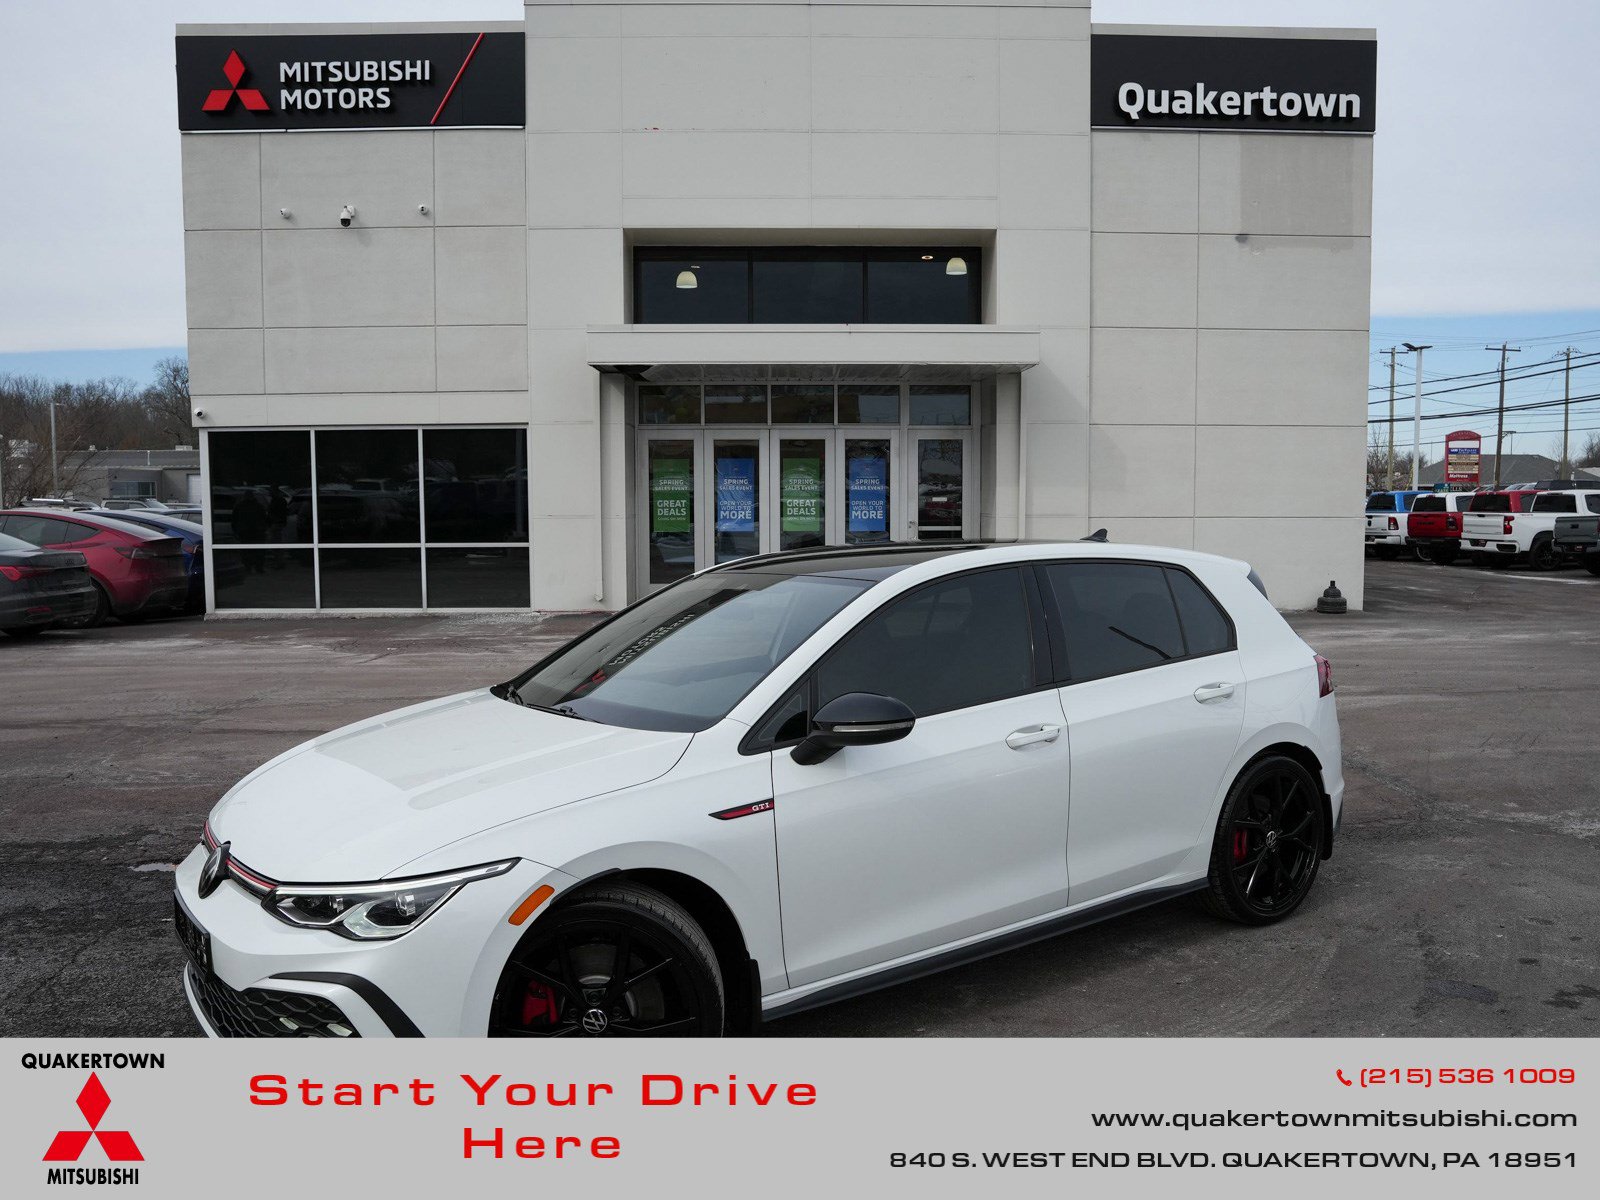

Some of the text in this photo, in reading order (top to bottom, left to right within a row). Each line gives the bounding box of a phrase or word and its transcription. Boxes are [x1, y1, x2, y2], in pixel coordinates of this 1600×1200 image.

[279, 59, 430, 83] MITSUBISHI
[280, 87, 391, 110] MOTORS
[1118, 82, 1361, 120] Quakertown
[656, 499, 687, 508] GREAT
[786, 499, 816, 507] GREAT
[657, 508, 687, 516] DEALS
[720, 510, 752, 519] MORE
[786, 507, 816, 516] DEALS
[851, 510, 884, 519] MORE
[751, 802, 770, 811] GTI
